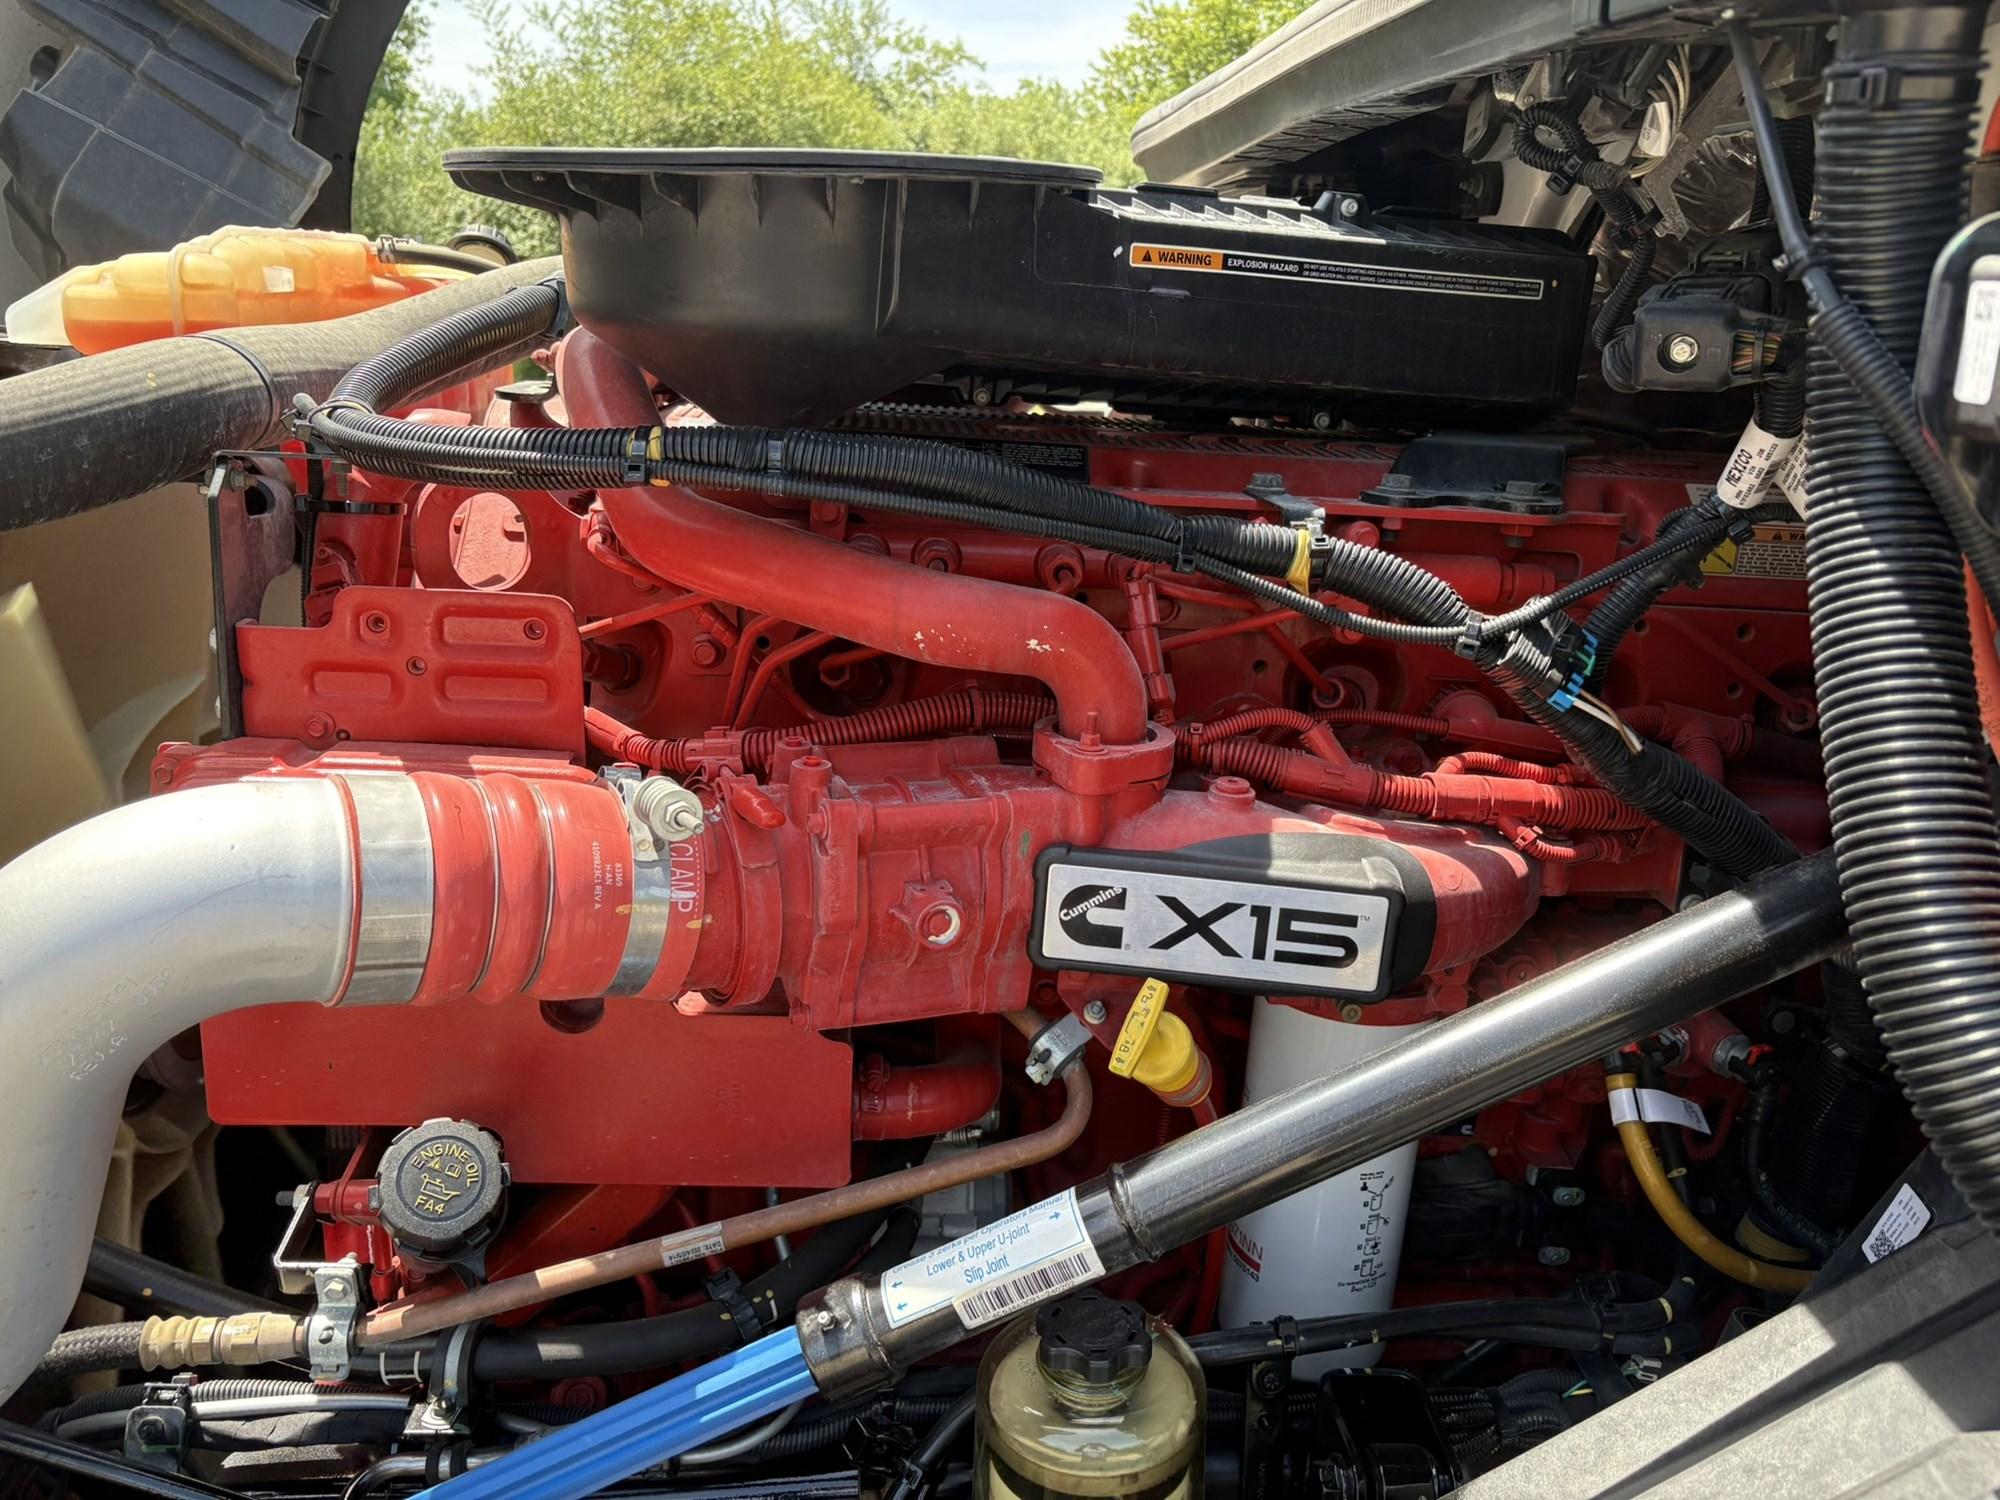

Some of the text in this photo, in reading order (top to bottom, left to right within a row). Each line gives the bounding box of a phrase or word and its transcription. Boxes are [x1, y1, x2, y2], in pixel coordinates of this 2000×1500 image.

[1158, 251, 1212, 266] WARNING
[1227, 258, 1299, 273] EXPLOSION HAZARD
[1725, 449, 1753, 487] MEXICO
[593, 883, 602, 901] REV
[670, 842, 697, 914] CLAMP
[593, 902, 602, 910] A
[1060, 886, 1123, 921] Cummins
[1148, 895, 1359, 969] X15
[411, 1143, 481, 1188] ENGINE OIL
[414, 1195, 446, 1216] FA4
[963, 1231, 979, 1246] per
[1029, 1194, 1064, 1215] Manual
[926, 1222, 1031, 1277] Lower & Upper U-joint
[964, 1255, 1011, 1285] Slip Joint
